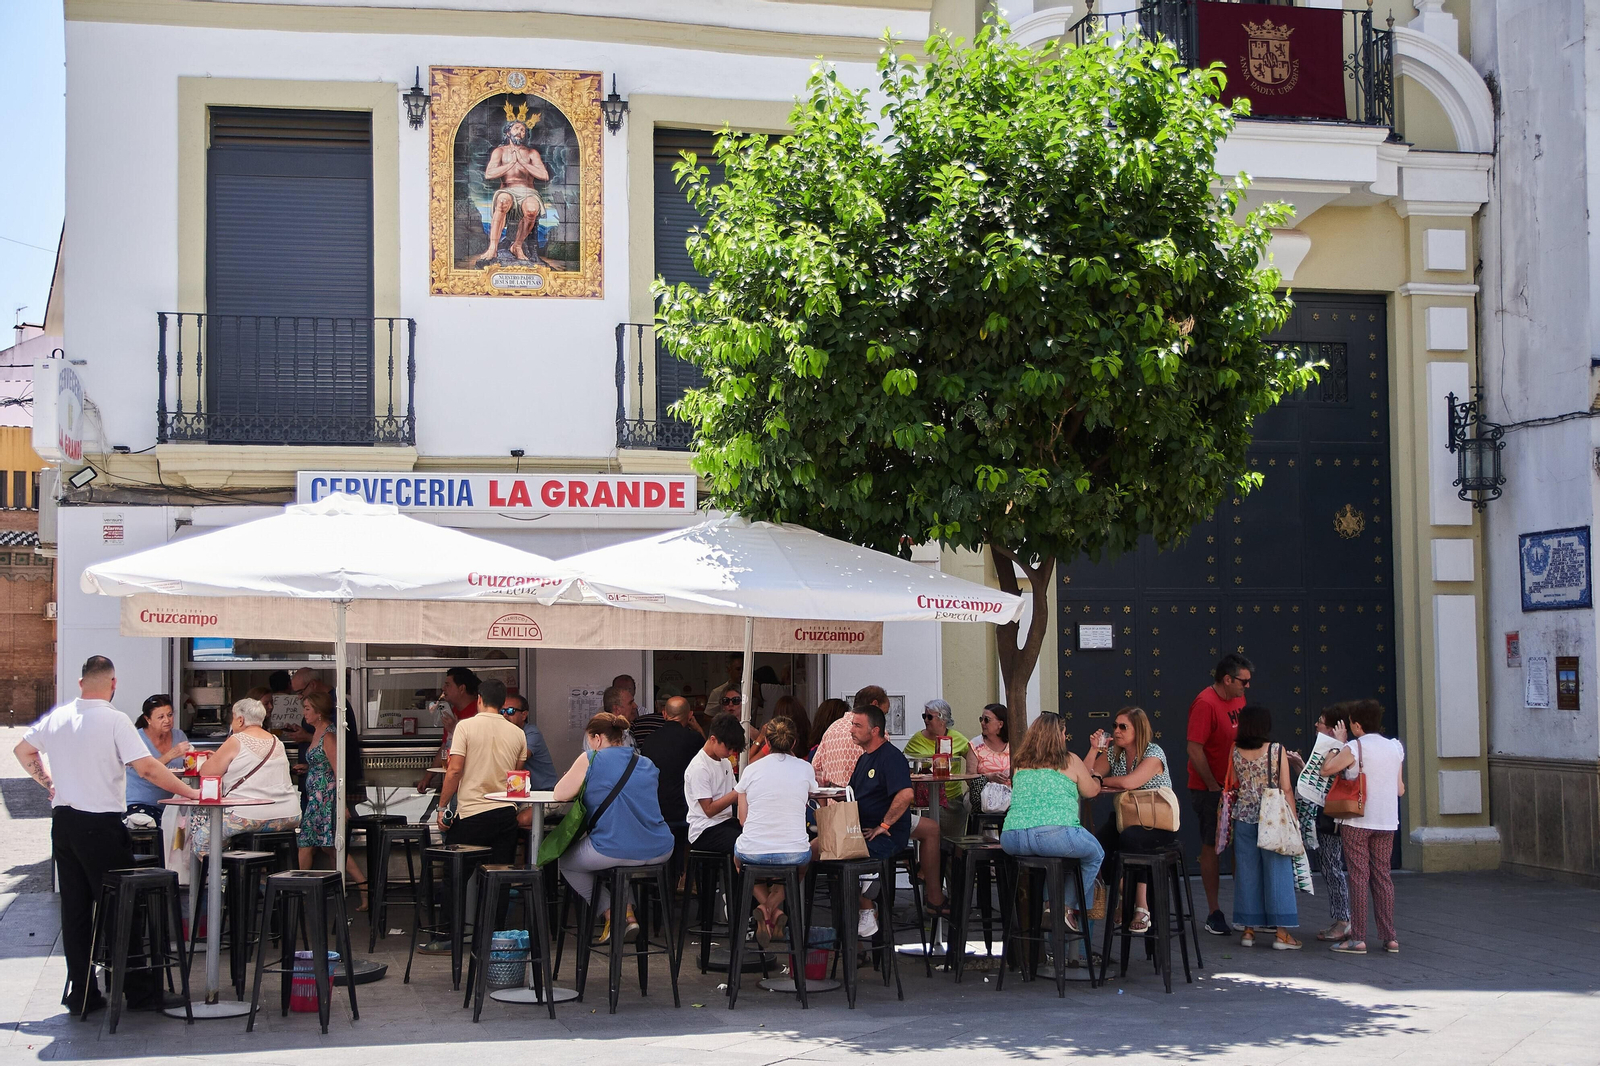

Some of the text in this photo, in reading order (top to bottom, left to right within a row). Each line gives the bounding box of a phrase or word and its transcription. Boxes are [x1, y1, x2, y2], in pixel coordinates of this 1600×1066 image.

[311, 477, 685, 508] CERVECERIA LA GRANDE
[468, 571, 562, 588] Cruzcampo
[917, 594, 1002, 614] Cruzcampo
[140, 609, 218, 627] Cruzcampo
[492, 626, 538, 637] EMILIO
[795, 628, 865, 643] Cruzcampo
[283, 696, 299, 706] SIR
[272, 713, 302, 721] ENTRO
